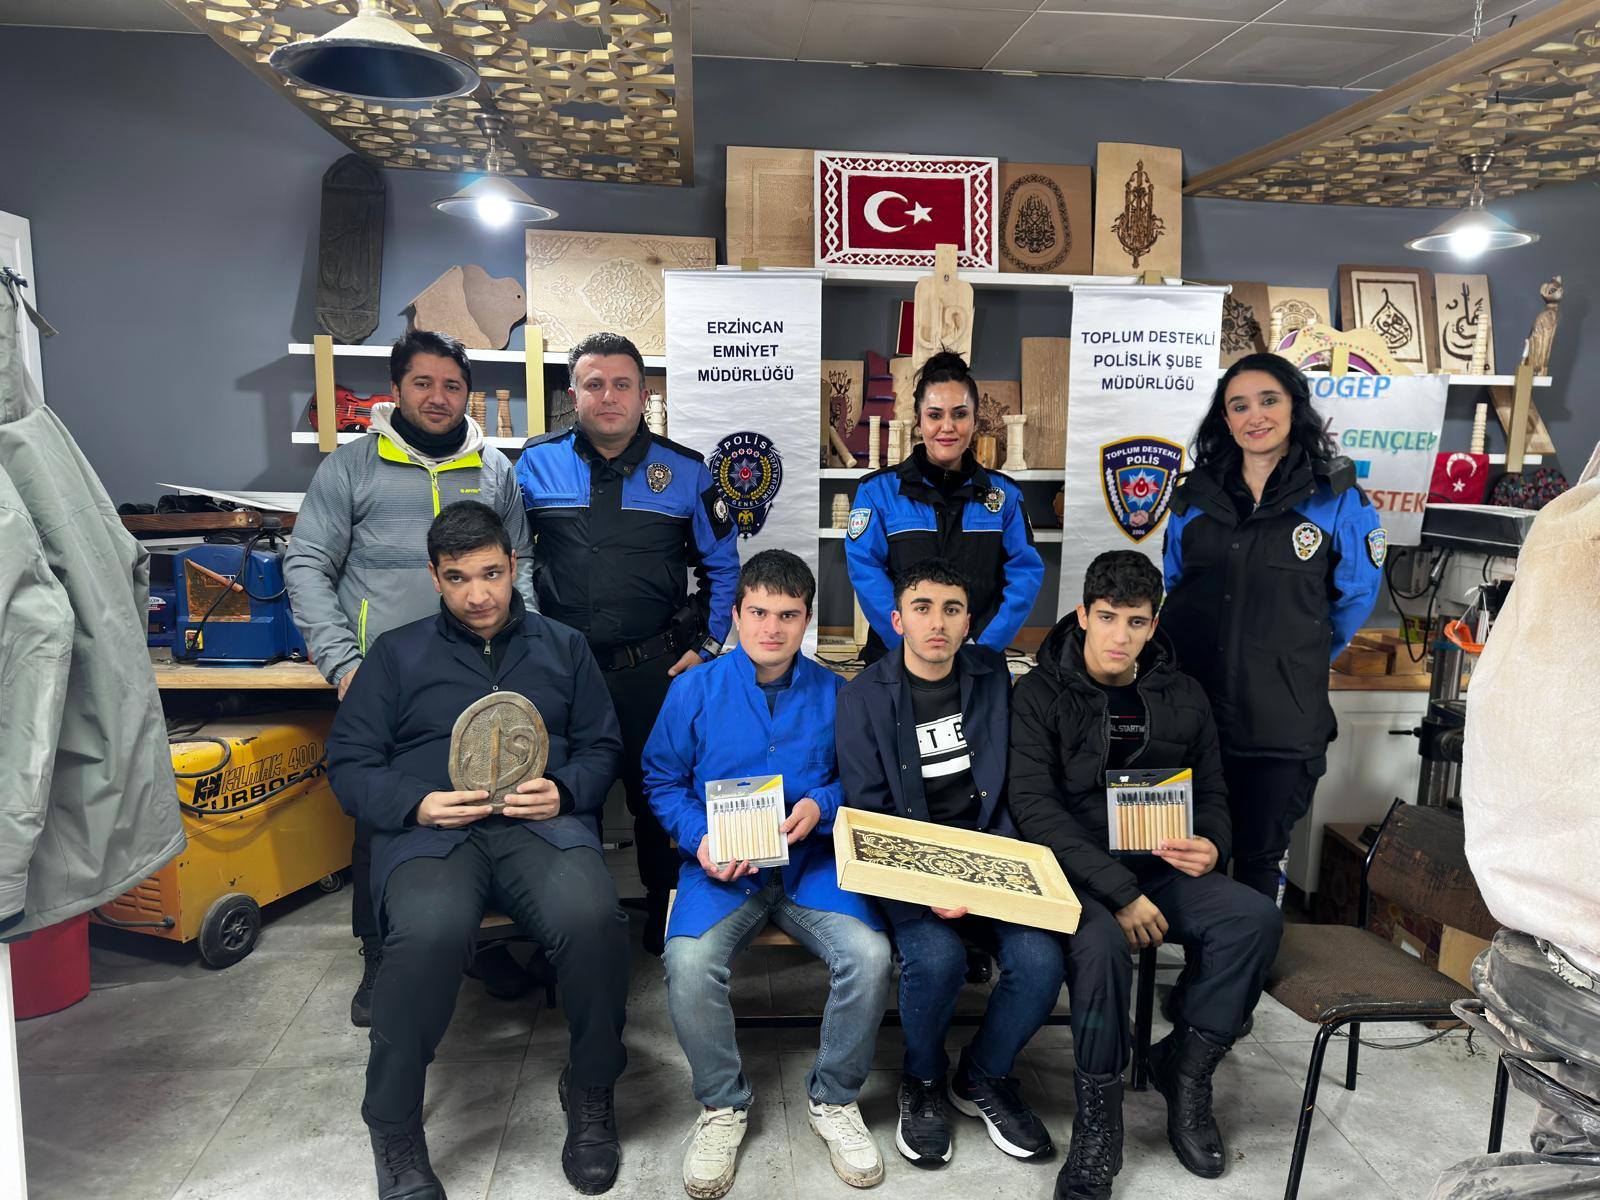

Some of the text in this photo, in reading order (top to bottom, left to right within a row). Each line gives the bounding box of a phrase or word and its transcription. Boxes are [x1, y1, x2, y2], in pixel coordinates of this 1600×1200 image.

[707, 317, 784, 334] ERZİNCAN
[1081, 330, 1216, 346] TOPLUM DESTEKLİ
[713, 342, 779, 357] EMNİYET
[1093, 350, 1203, 370] POLİSLİK ŞUBE
[698, 365, 794, 381] MÜDÜRLÜĞÜ
[1101, 374, 1195, 391] MÜDÜRLÜĞÜ
[1307, 376, 1392, 398] OGEP
[723, 434, 768, 450] POLİS
[1105, 445, 1182, 461] TOPLUM DESTEKLİ
[1126, 454, 1160, 465] POLİS
[288, 742, 318, 770] 400
